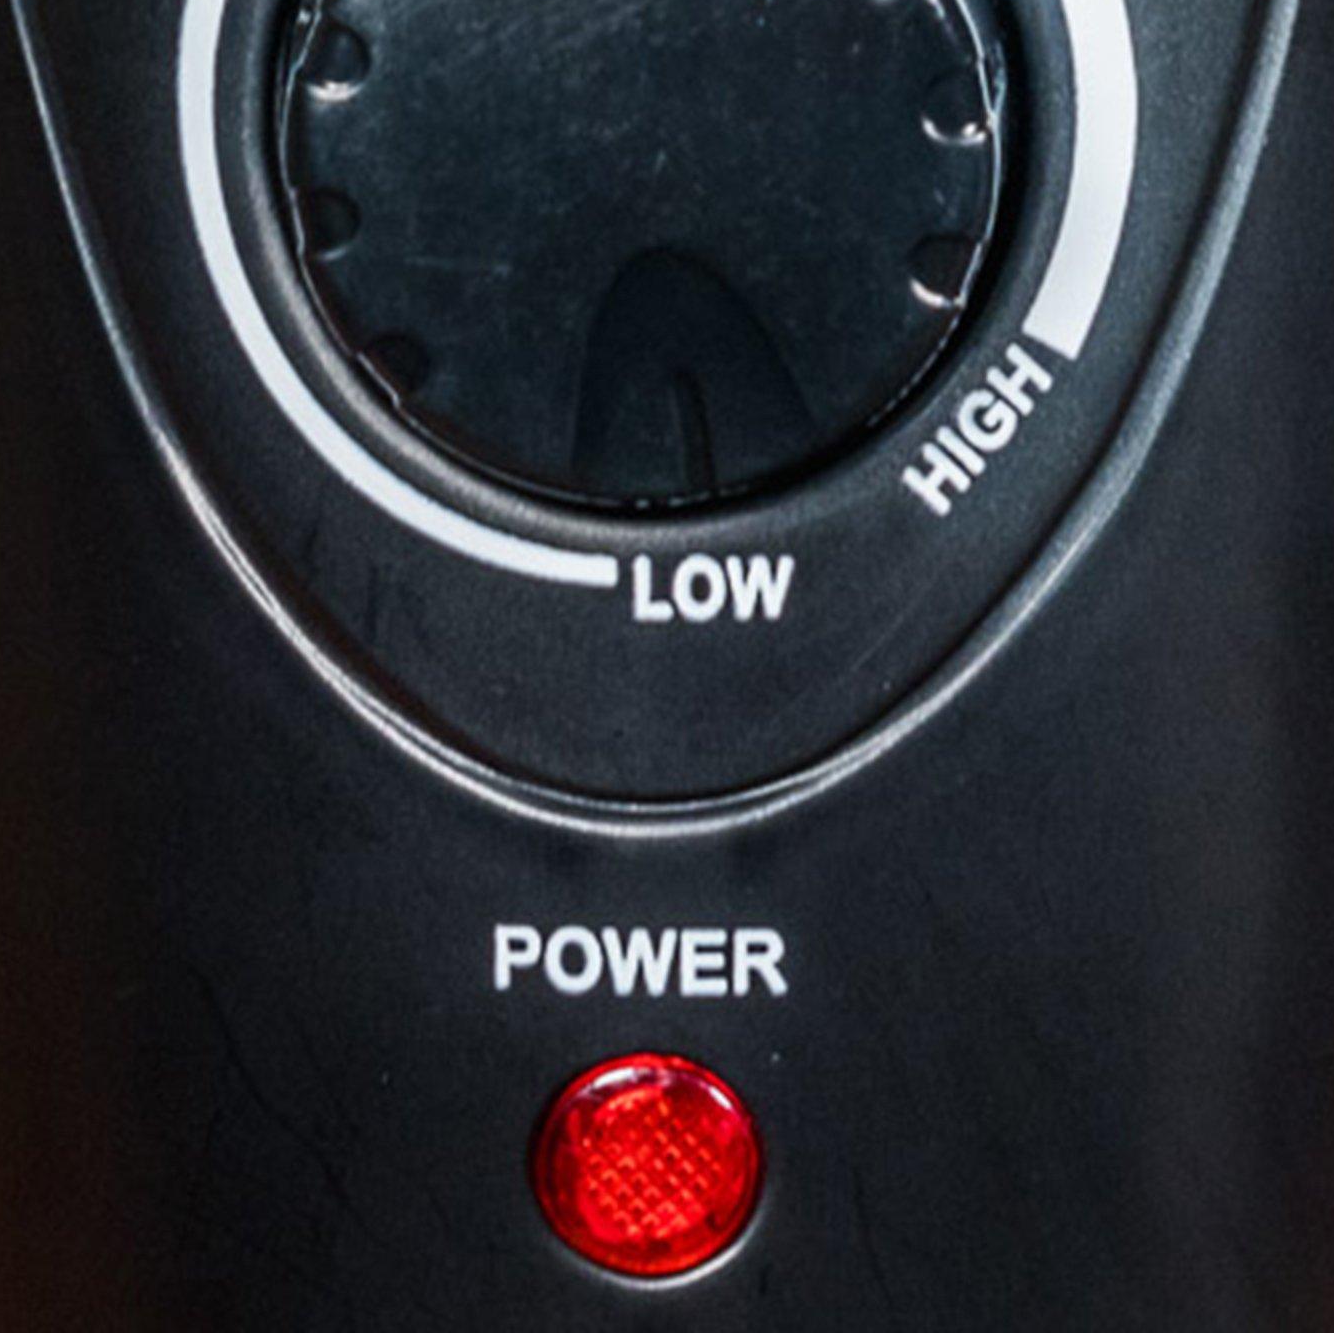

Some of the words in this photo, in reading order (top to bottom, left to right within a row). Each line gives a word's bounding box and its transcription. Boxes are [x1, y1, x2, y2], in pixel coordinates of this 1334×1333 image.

[901, 343, 1053, 516] HIGH
[631, 553, 796, 622] LOW
[493, 923, 788, 997] POWER
